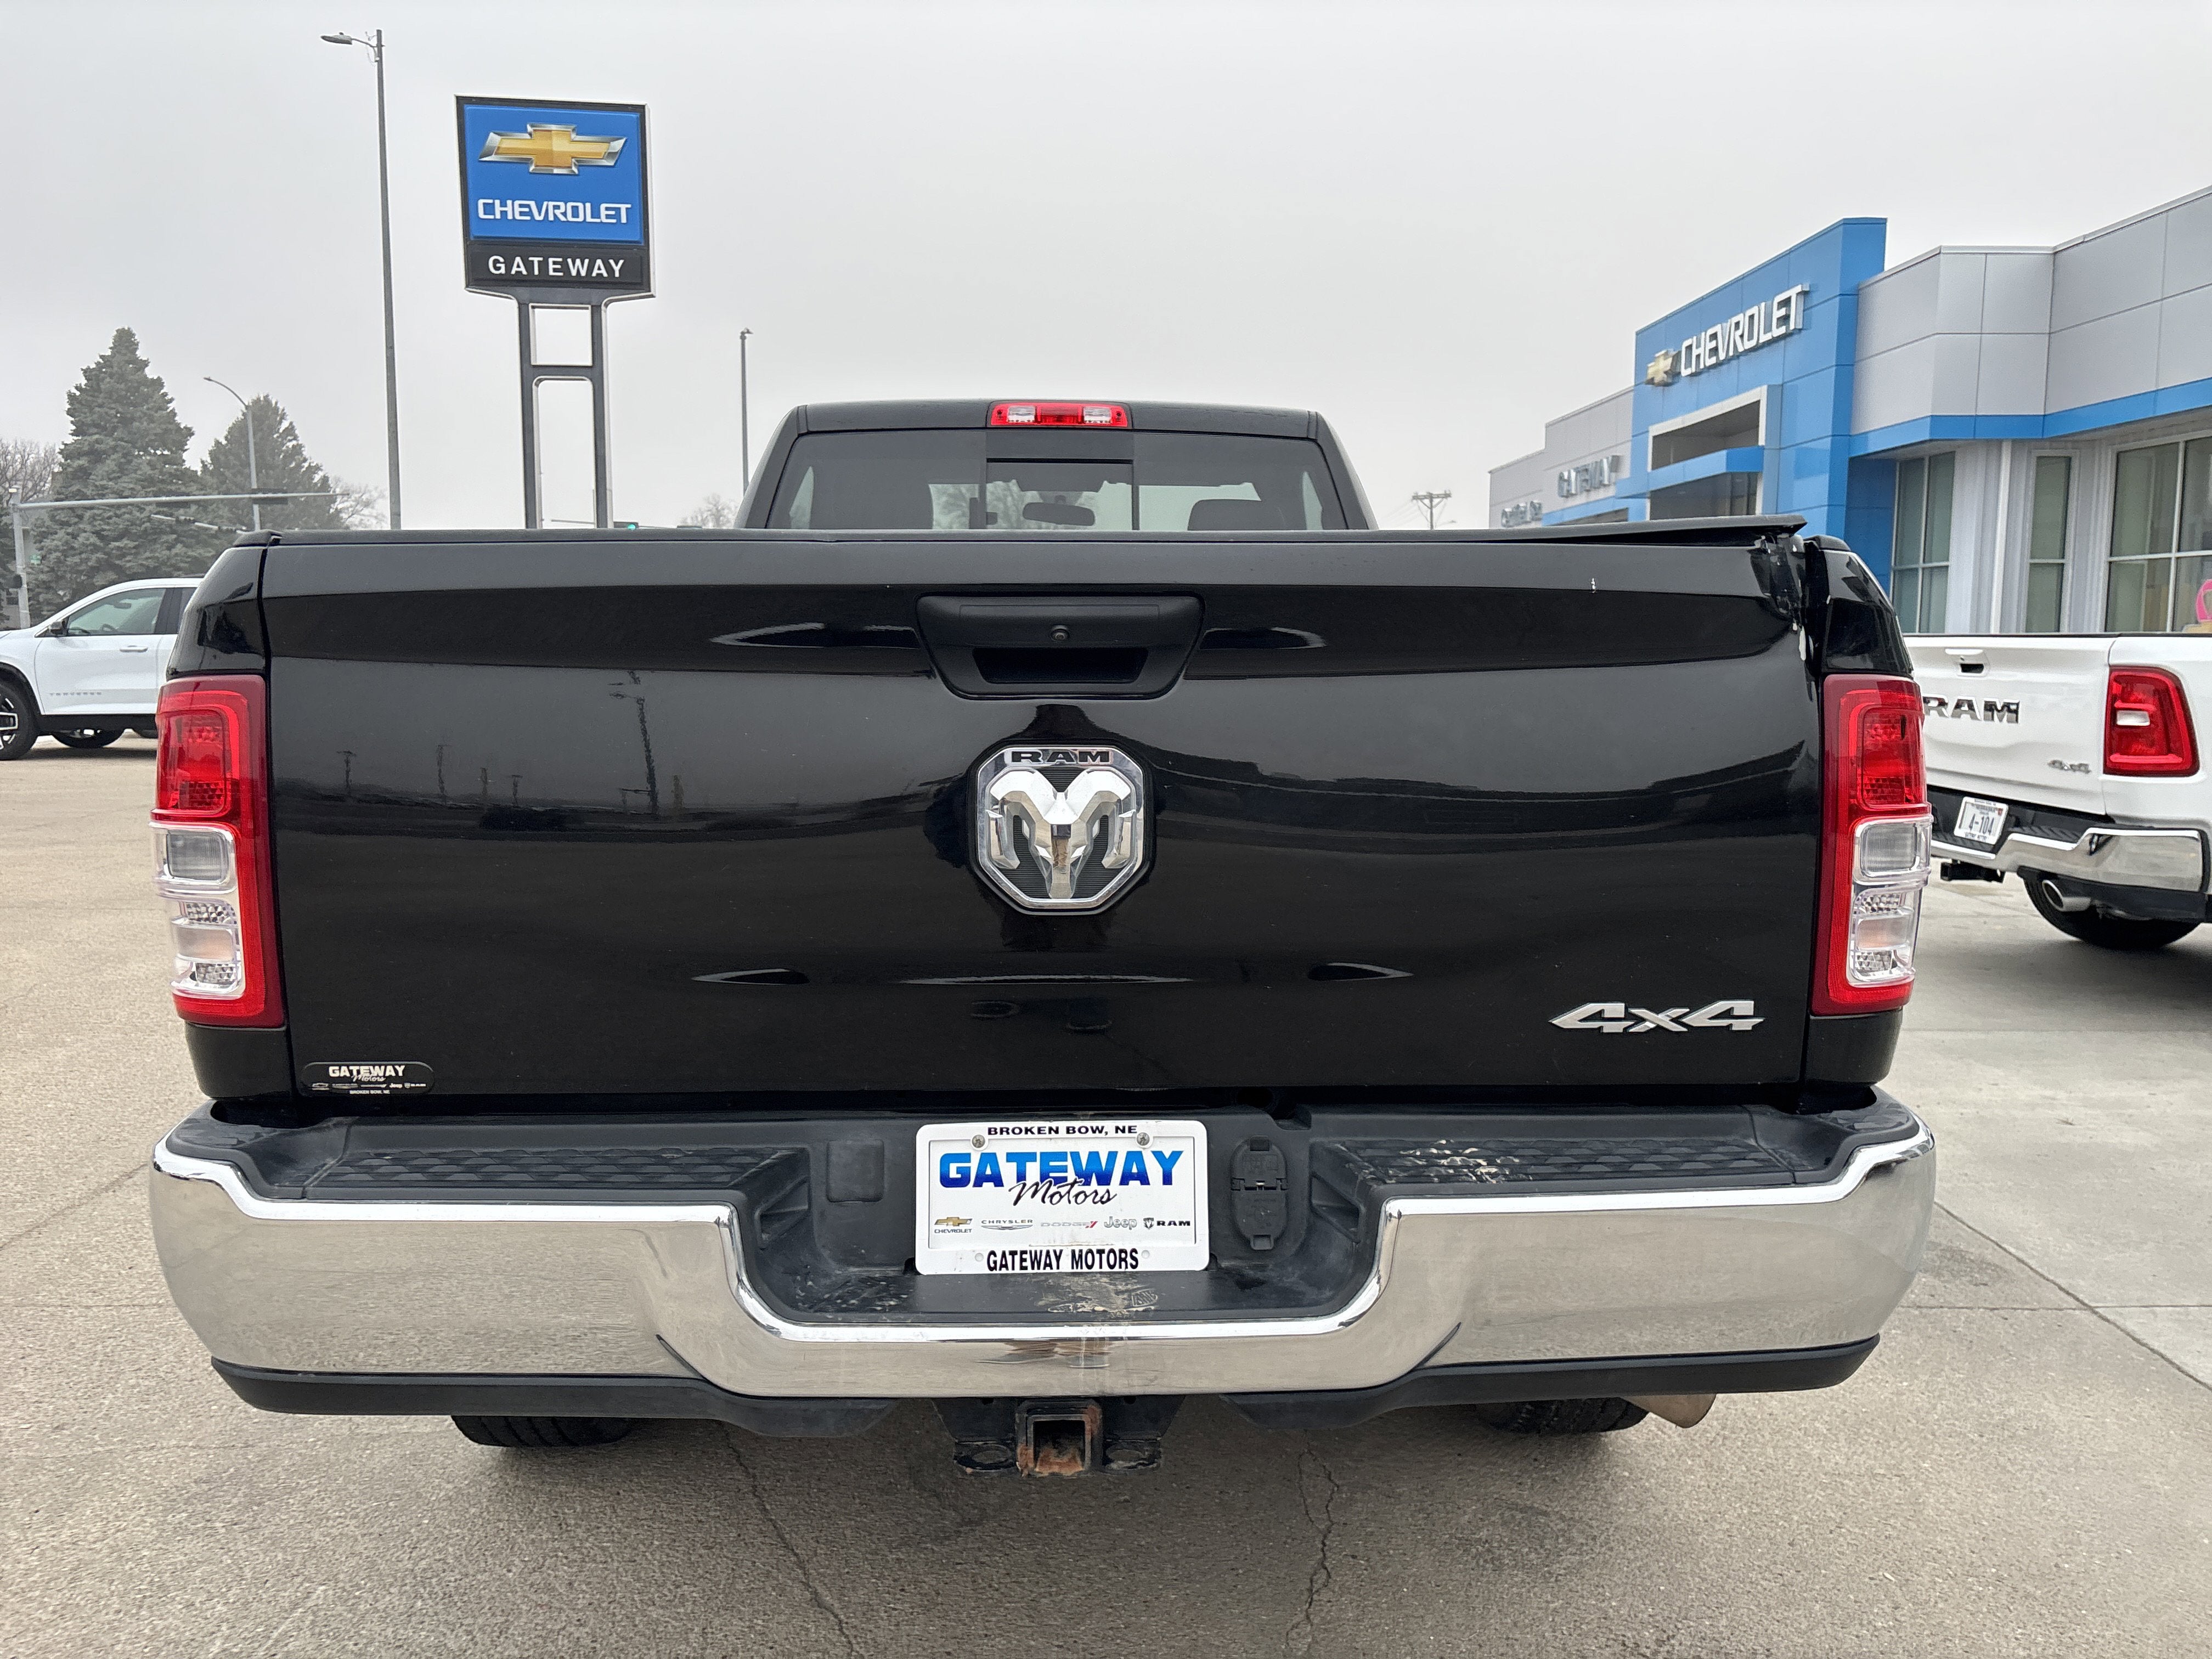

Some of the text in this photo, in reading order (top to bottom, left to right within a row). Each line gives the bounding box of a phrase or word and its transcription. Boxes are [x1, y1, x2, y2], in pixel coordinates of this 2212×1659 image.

[477, 199, 631, 224] CHEVROLET
[488, 255, 625, 278] GATEWAY
[1681, 284, 1806, 377] CHEVROLET
[1922, 693, 2021, 724] RAM
[1011, 751, 1110, 763] RAM
[1548, 999, 1765, 1033] 4x4
[329, 1065, 405, 1077] GATEWAY
[351, 1073, 386, 1082] Motors
[988, 1125, 1137, 1136] BROKEN BOW, NE
[939, 1150, 1184, 1188] GATEWAY
[1008, 1178, 1118, 1206] Motors
[1104, 1216, 1137, 1230] Jeep
[987, 1248, 1139, 1272] GATEWAY MOTORS
